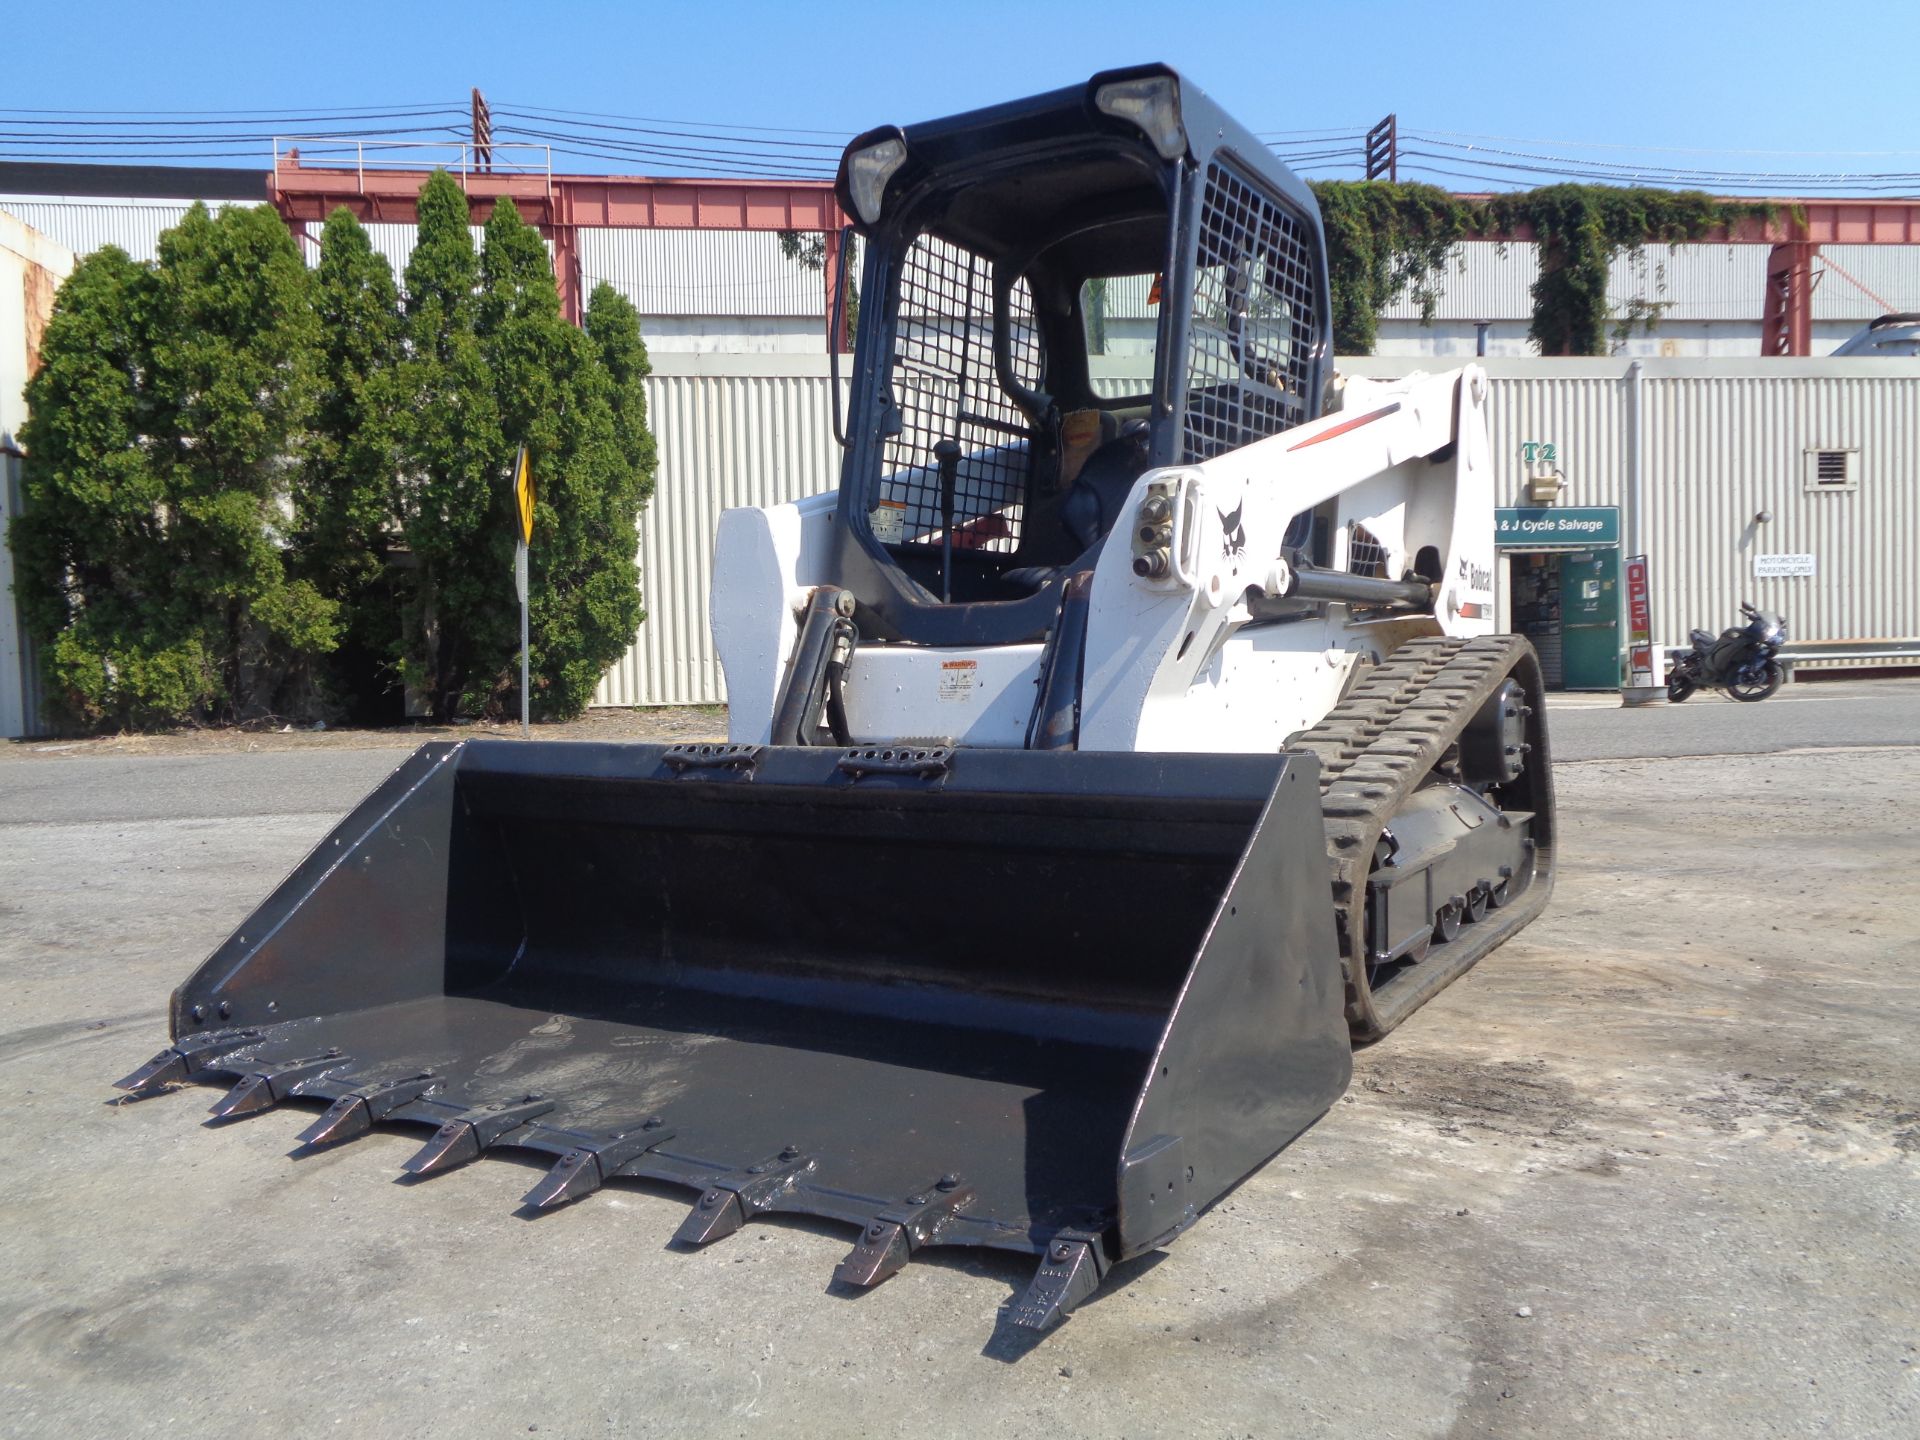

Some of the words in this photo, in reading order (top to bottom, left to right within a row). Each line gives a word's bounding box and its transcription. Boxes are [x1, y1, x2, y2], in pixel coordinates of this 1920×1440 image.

[1500, 520, 1509, 531] &
[1512, 520, 1520, 531] J
[1522, 519, 1555, 533] Cycle
[1558, 519, 1603, 532] Salvage
[1470, 563, 1492, 592] Bobcat
[1758, 566, 1791, 574] PARKING
[1627, 564, 1649, 632] OPEN
